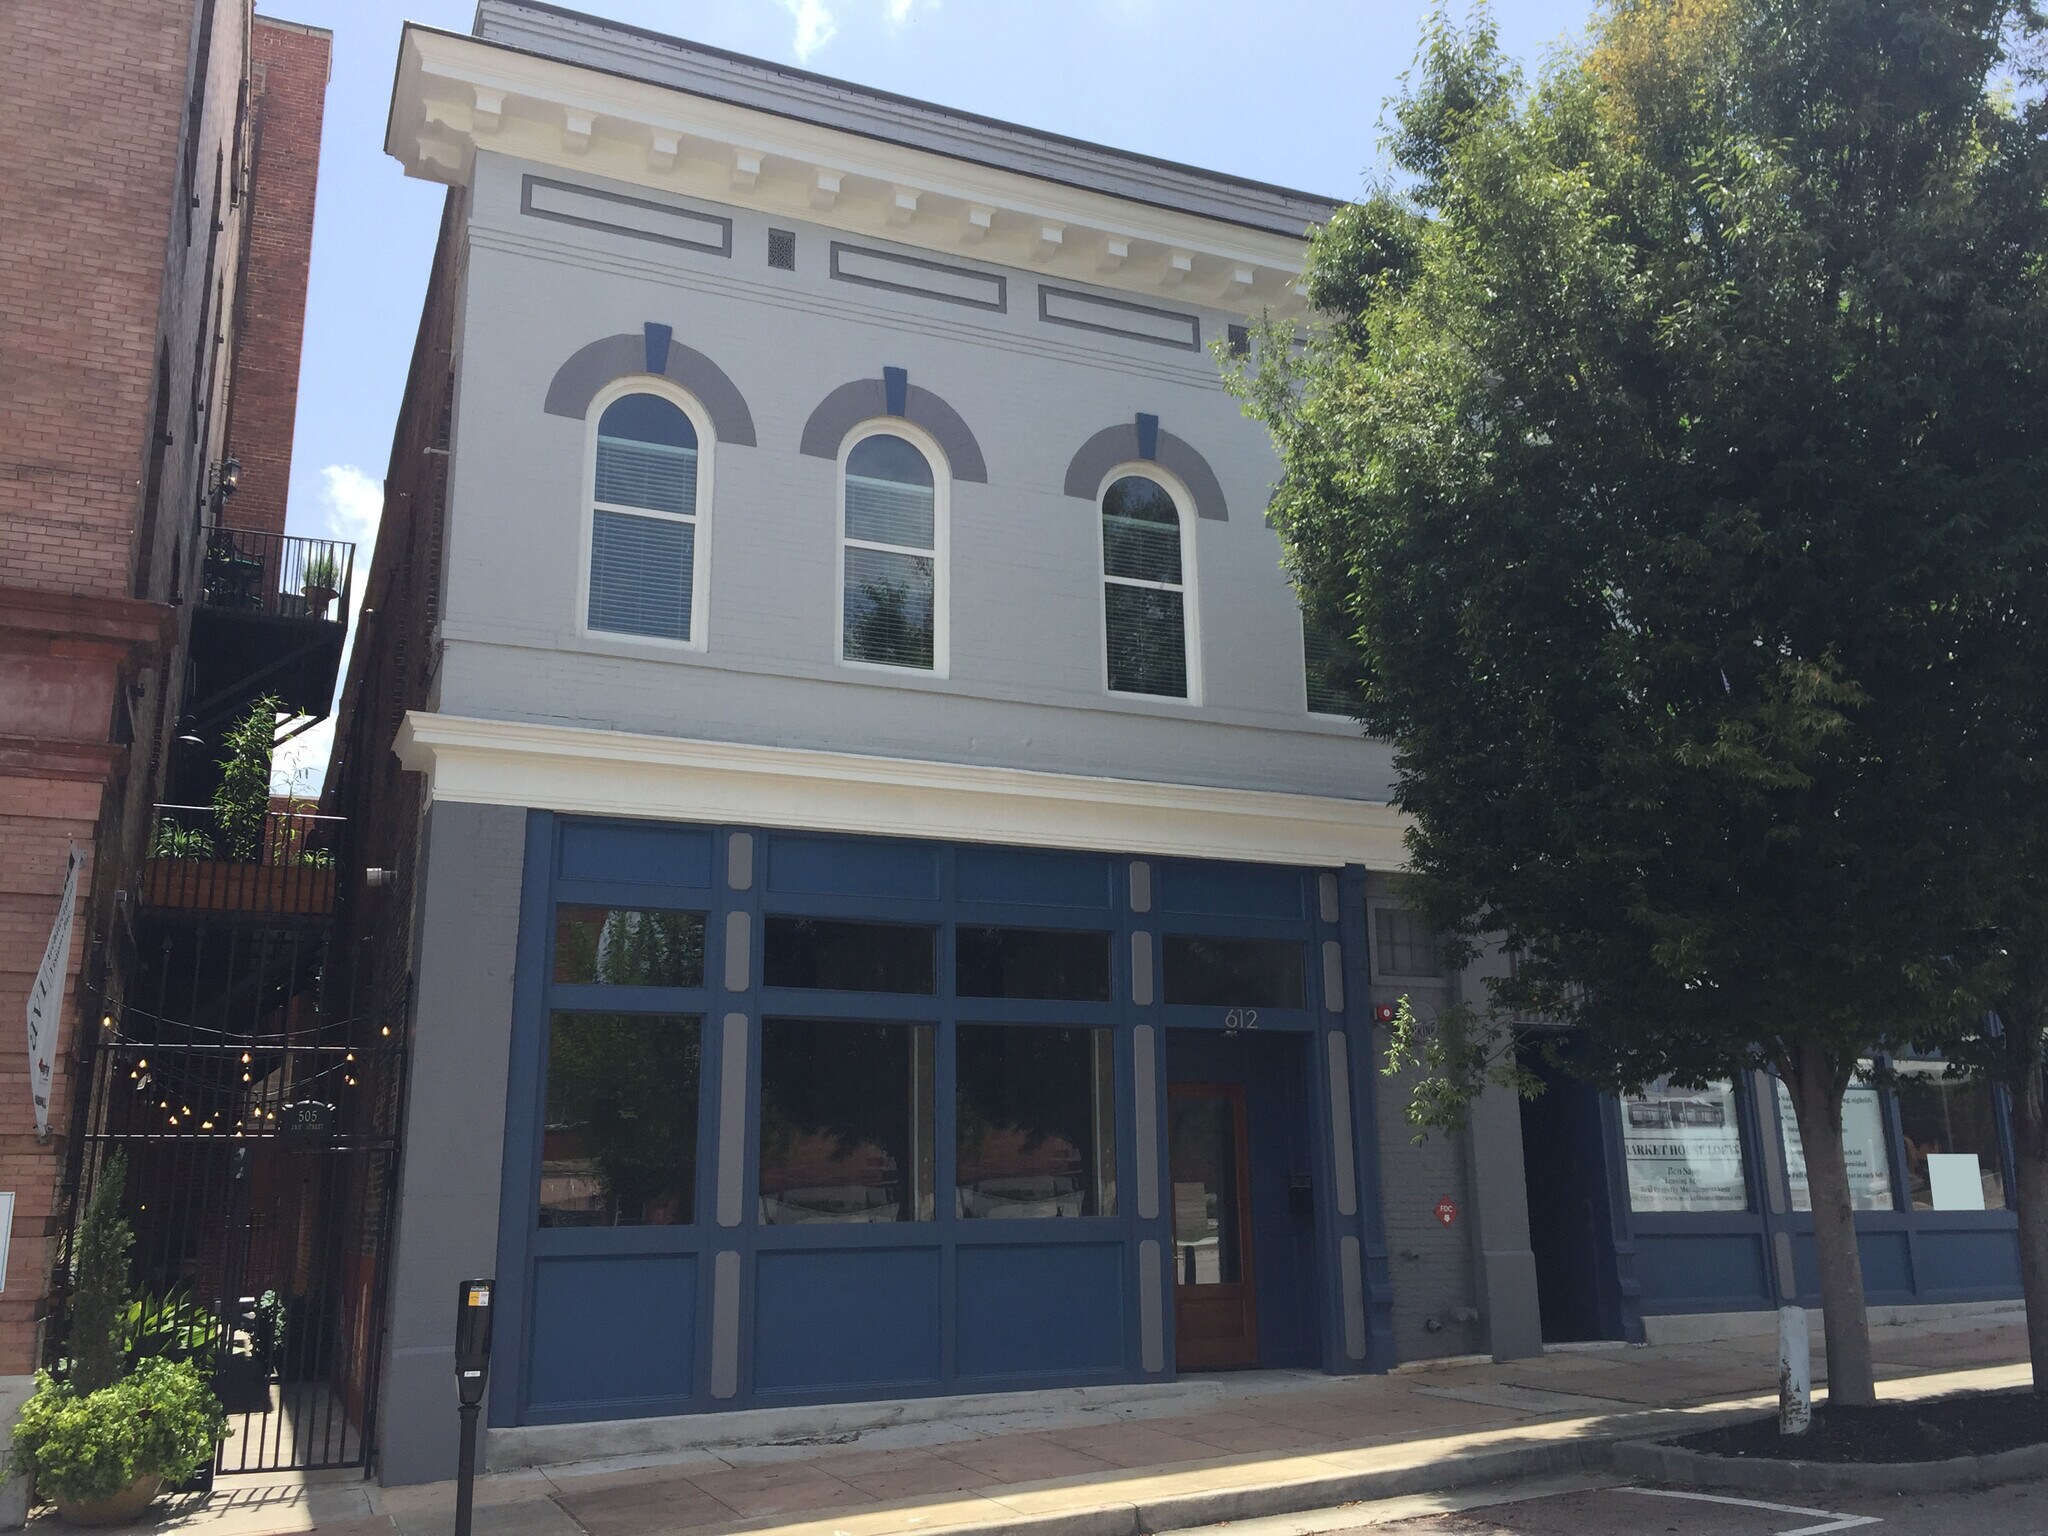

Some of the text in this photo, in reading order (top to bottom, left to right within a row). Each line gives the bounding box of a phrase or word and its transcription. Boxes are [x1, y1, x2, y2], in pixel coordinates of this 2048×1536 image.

[1225, 1009, 1258, 1029] 612
[298, 1110, 318, 1122] 505
[1440, 1205, 1453, 1213] FDC
